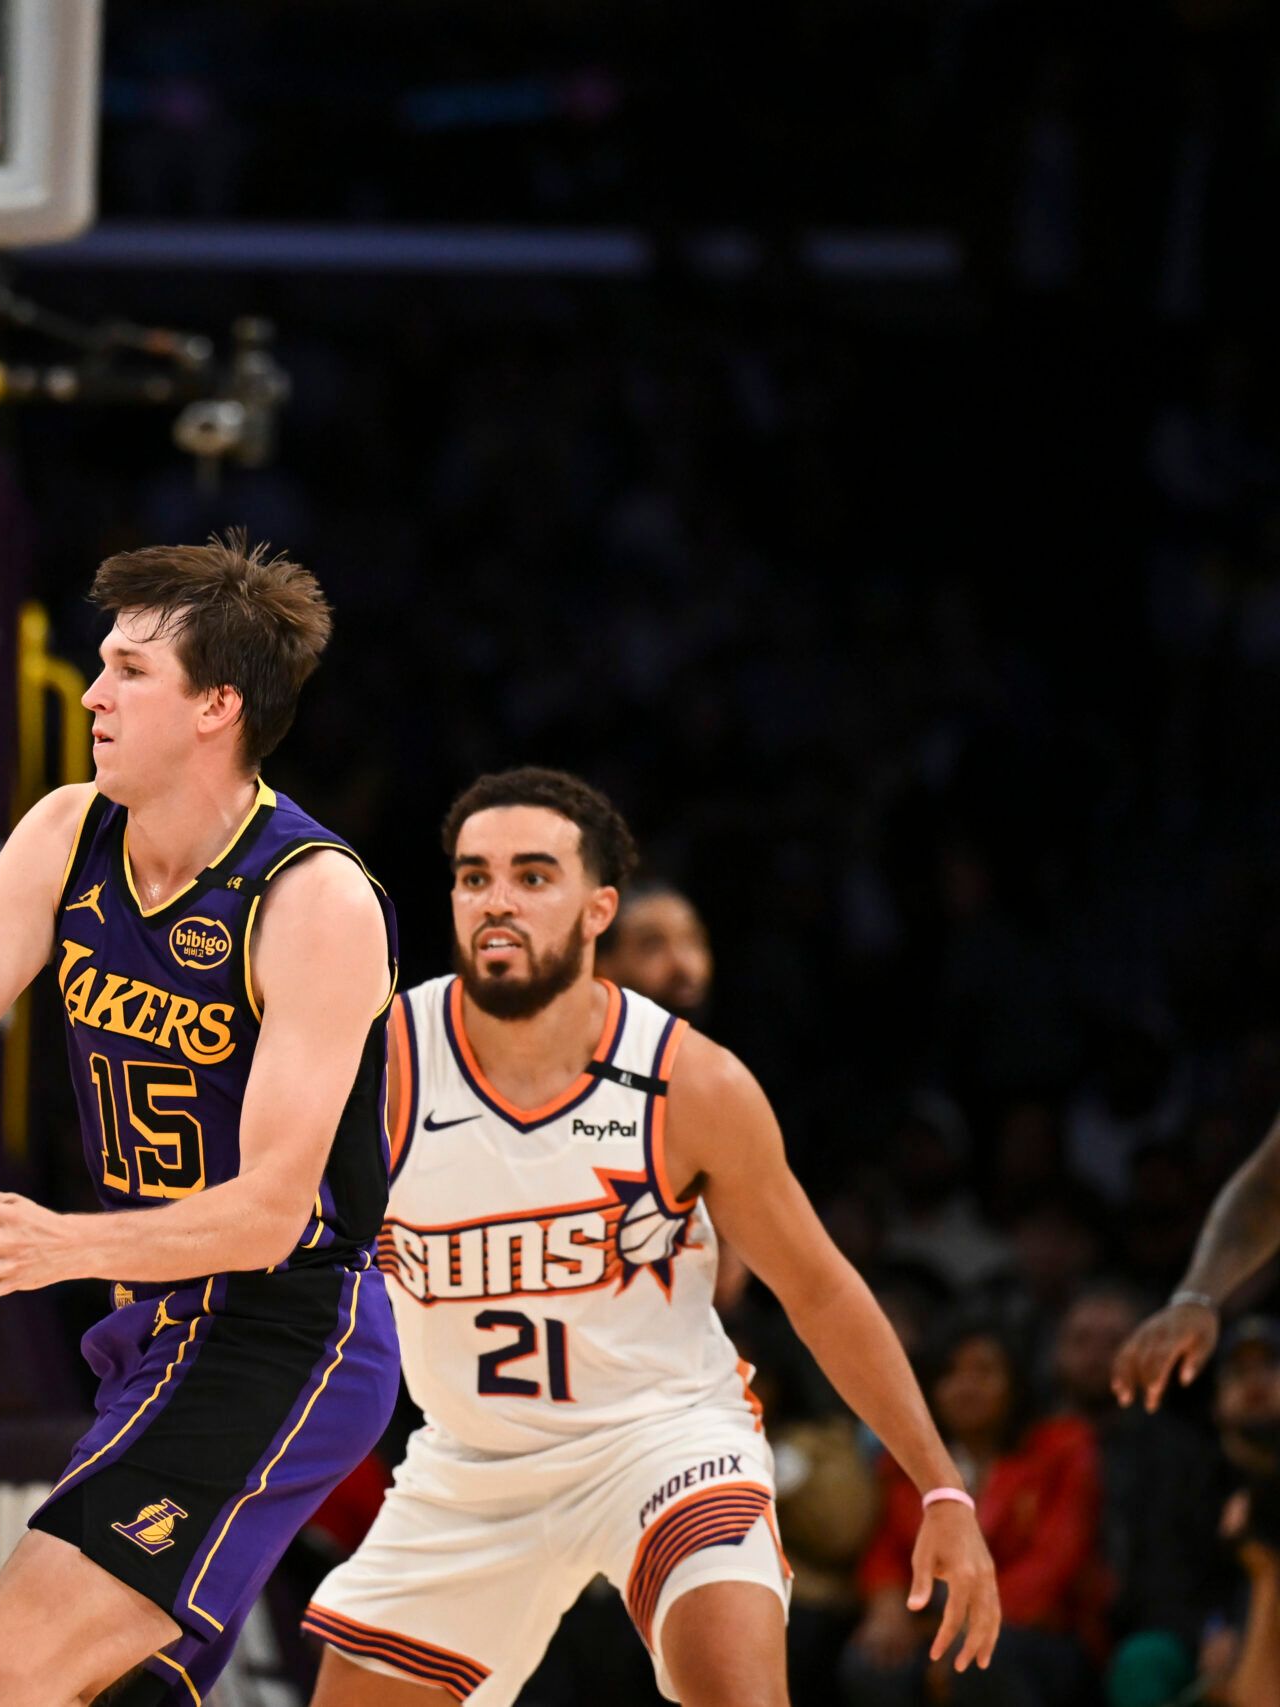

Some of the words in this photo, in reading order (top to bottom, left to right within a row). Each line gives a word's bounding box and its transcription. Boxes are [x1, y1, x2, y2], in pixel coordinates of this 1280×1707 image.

[176, 928, 227, 956] bibigo
[183, 946, 204, 958] 비비고
[58, 939, 236, 1065] LAKERS
[89, 1052, 206, 1199] 15
[572, 1119, 637, 1141] PayPal
[390, 1211, 607, 1301] SUNS
[474, 1309, 578, 1404] 21
[639, 1453, 743, 1530] PHOENIX
